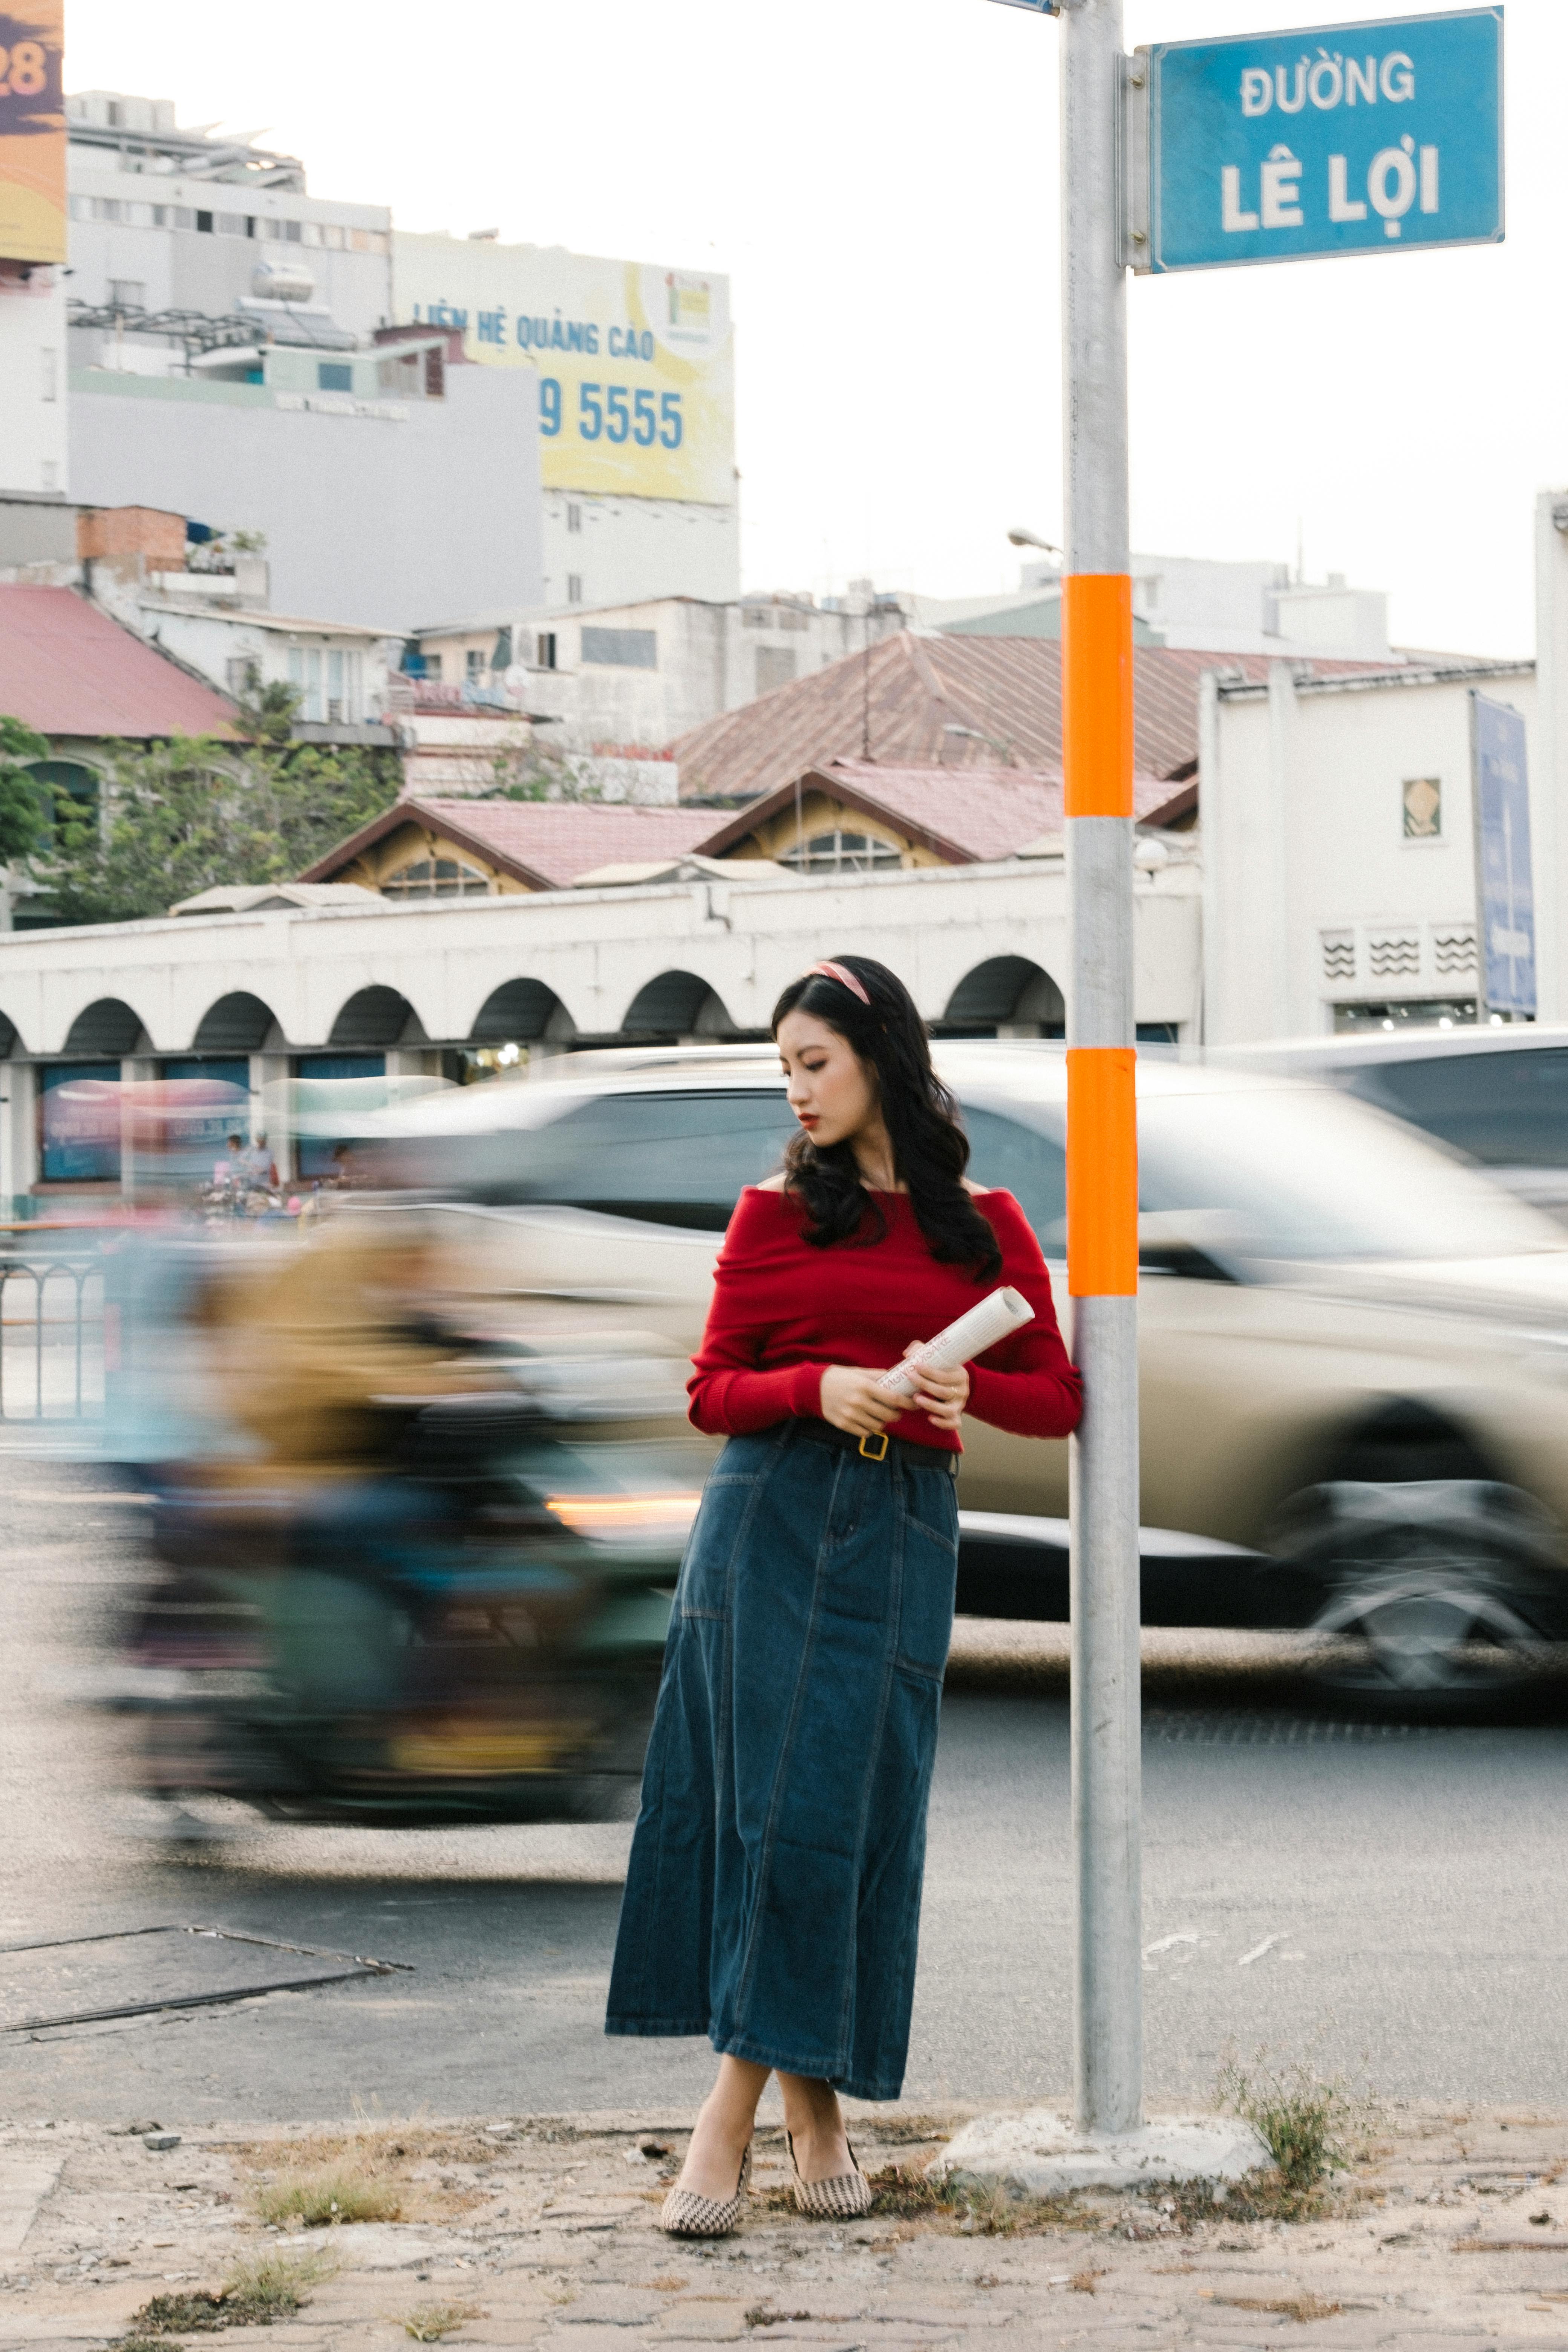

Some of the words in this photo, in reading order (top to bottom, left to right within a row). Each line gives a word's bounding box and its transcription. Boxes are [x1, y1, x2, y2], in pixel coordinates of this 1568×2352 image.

[1240, 46, 1415, 117] ĐƯỜNG
[1221, 143, 1304, 233] LÊ
[1328, 133, 1439, 238] LỢI
[579, 381, 683, 449] 5555
